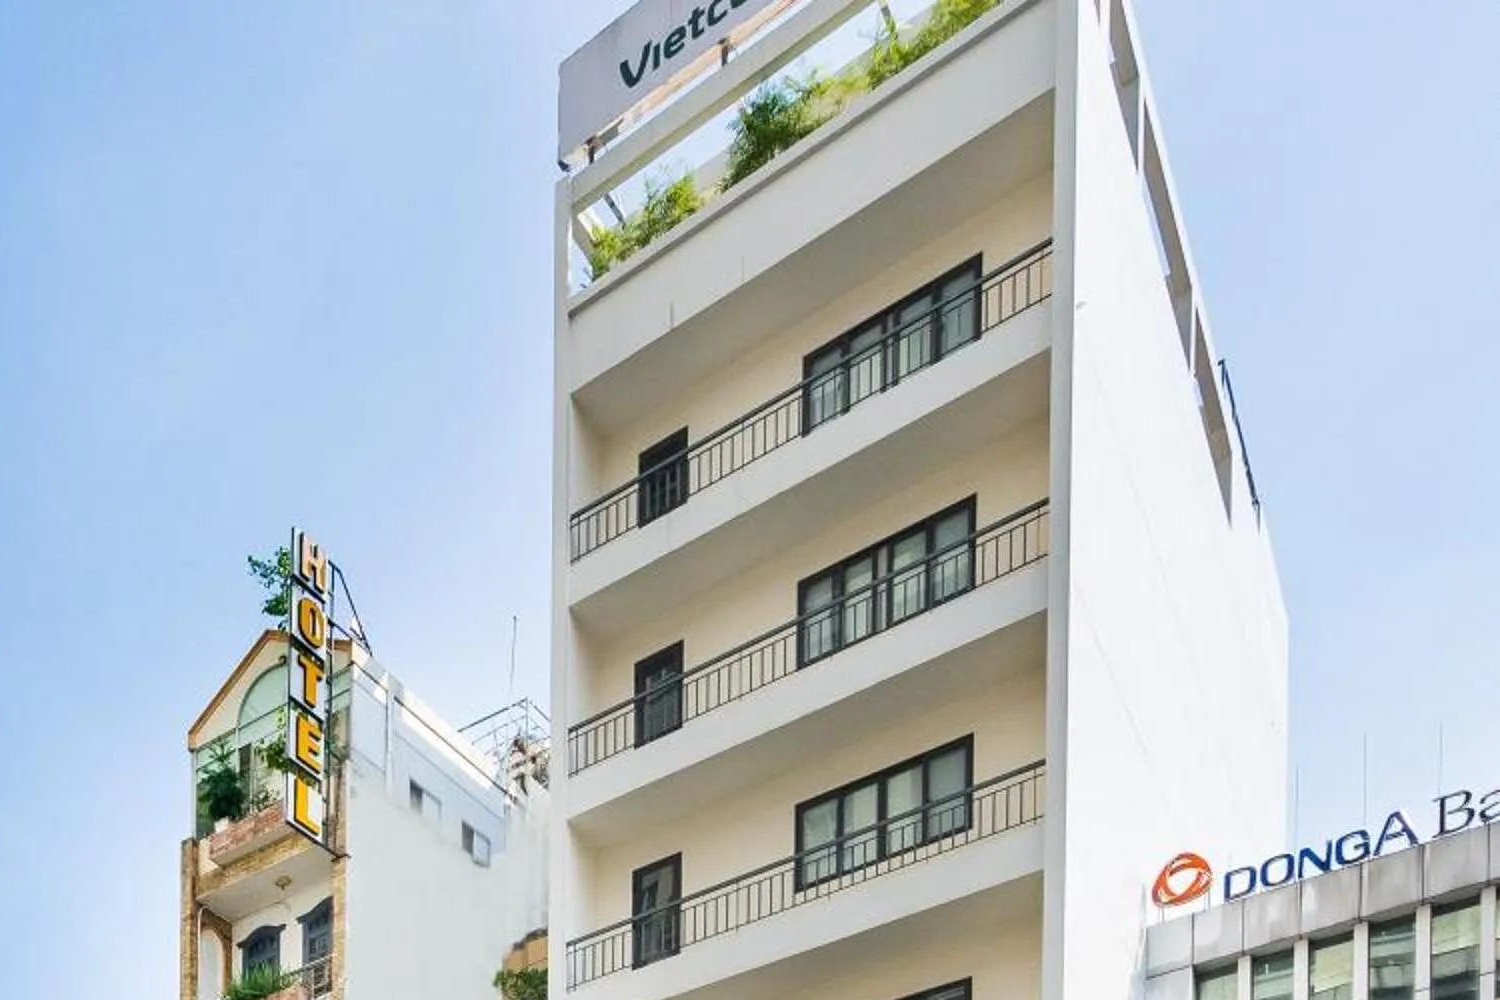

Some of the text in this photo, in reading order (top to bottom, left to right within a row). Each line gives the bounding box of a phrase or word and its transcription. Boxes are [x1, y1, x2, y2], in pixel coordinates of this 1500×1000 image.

[619, 0, 748, 88] Vietc
[295, 532, 326, 835] HOTEL
[1224, 810, 1419, 901] DONGA
